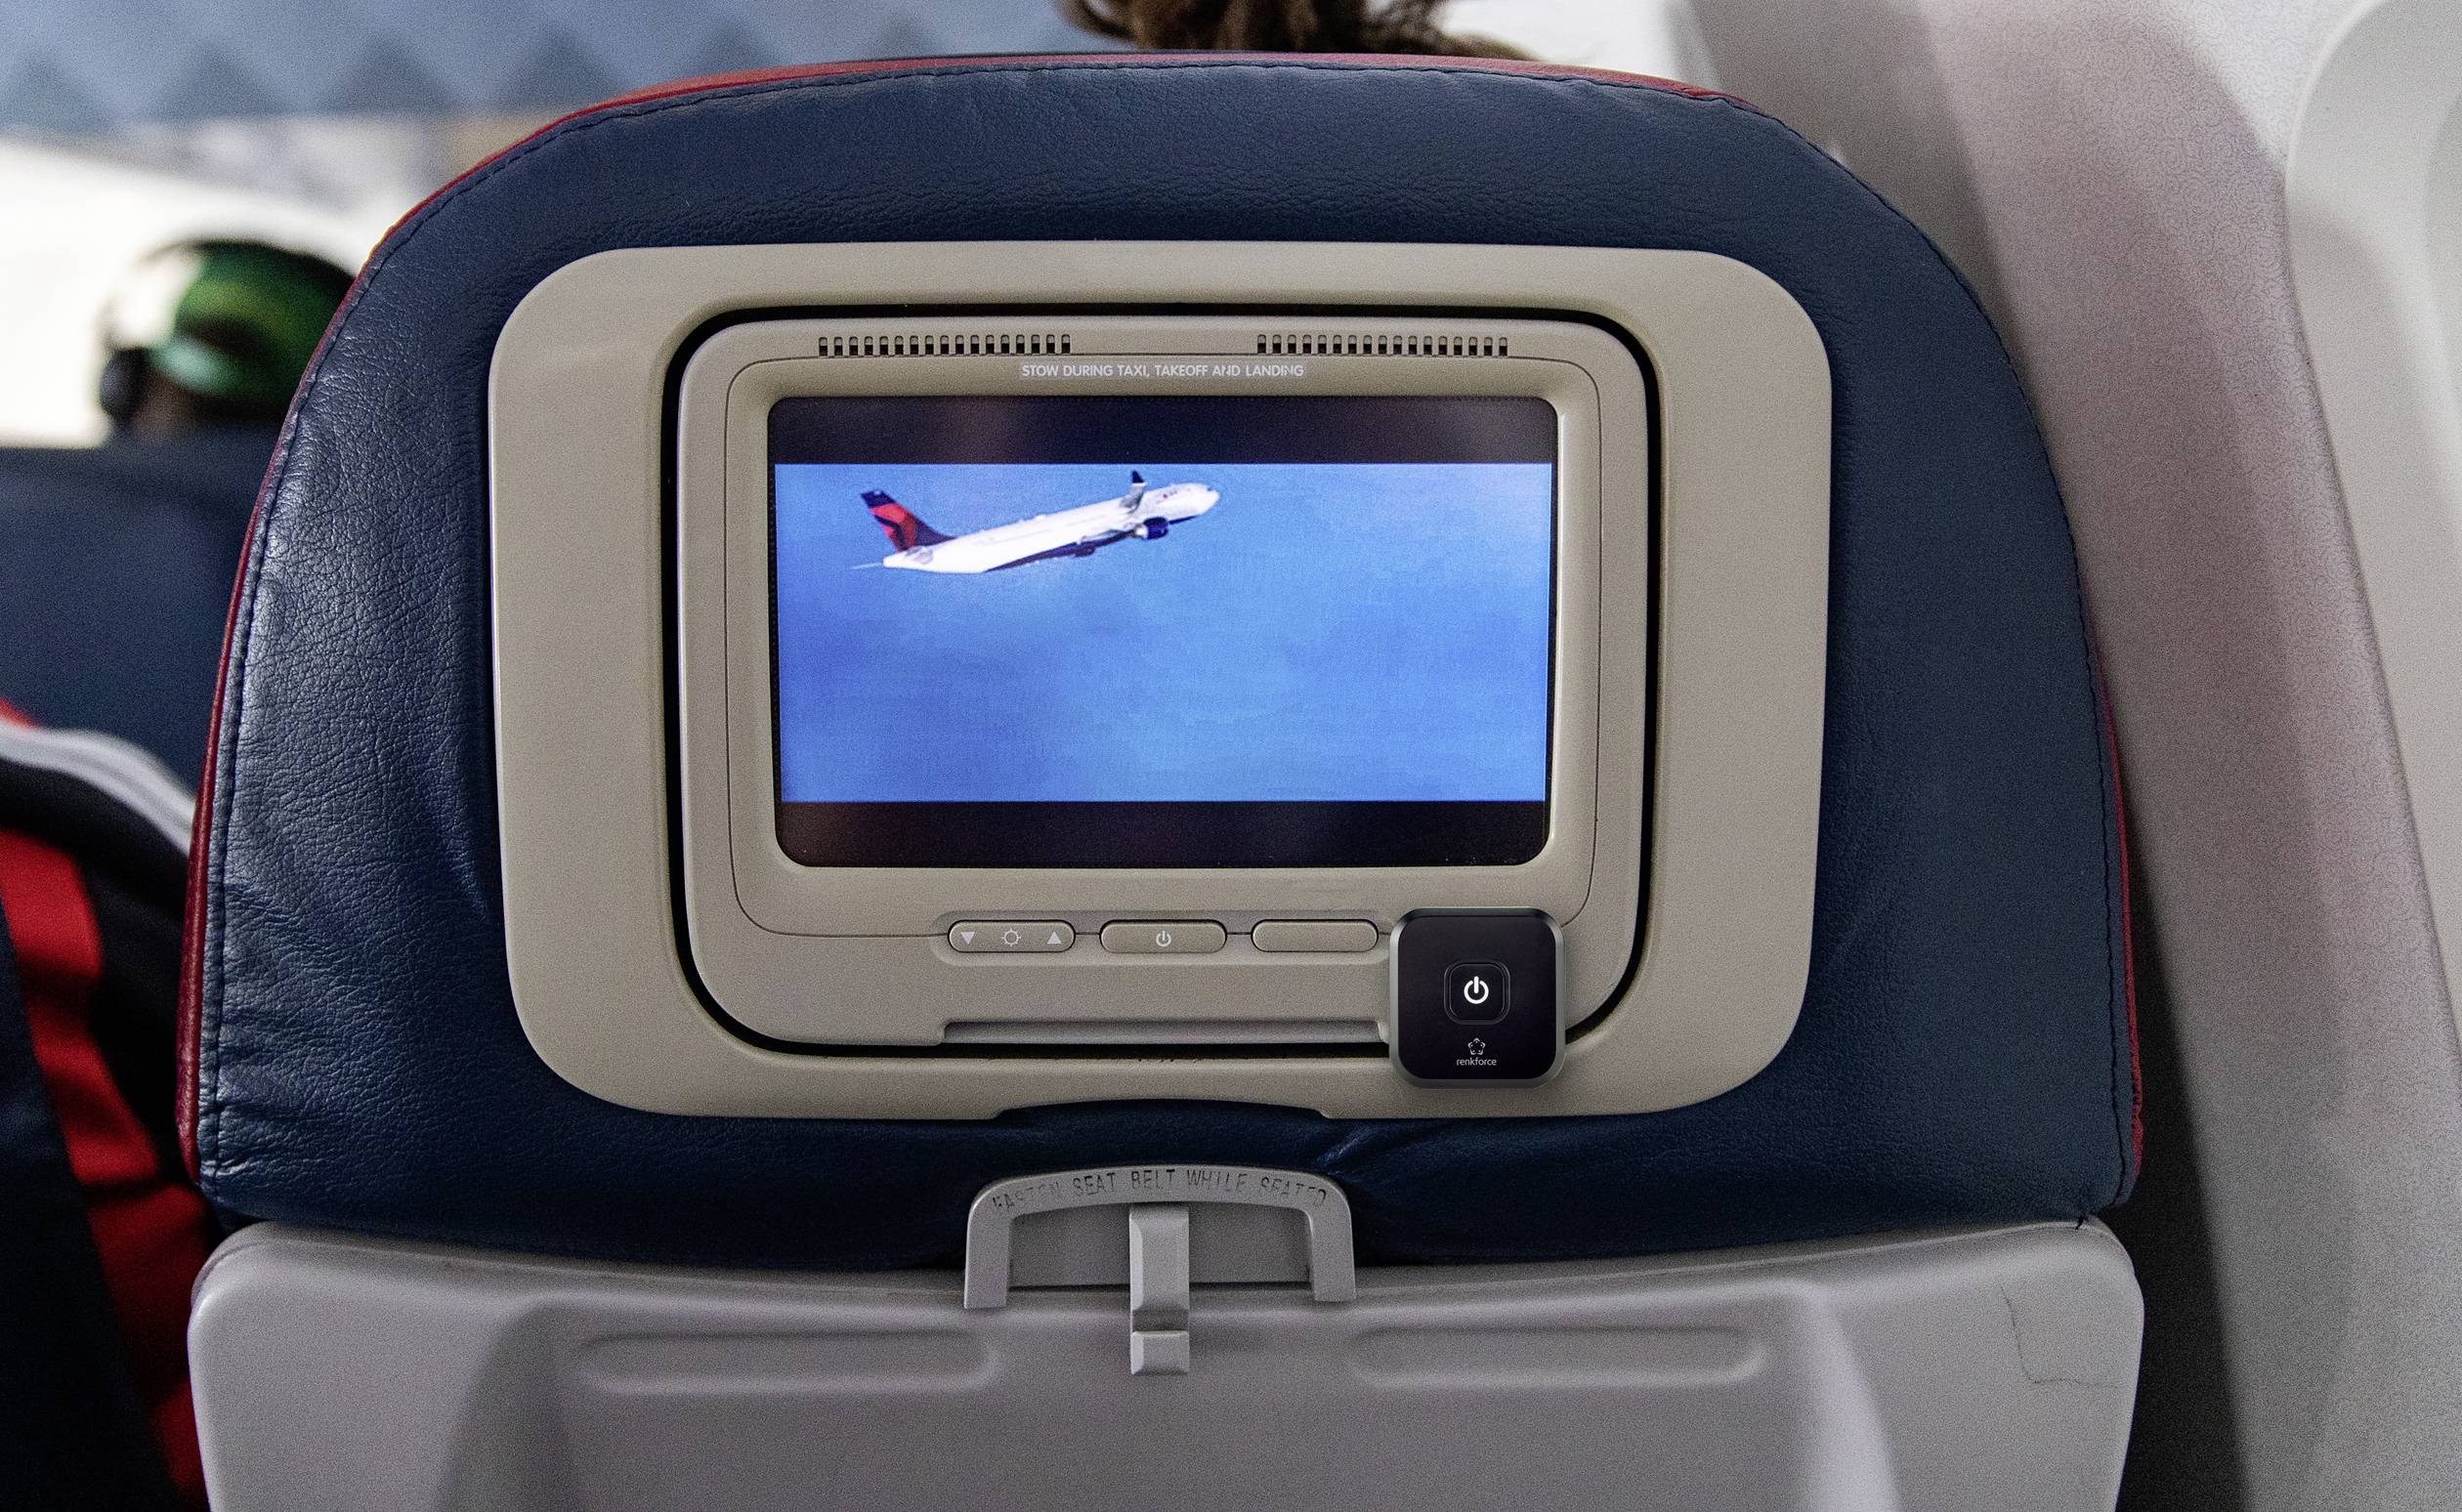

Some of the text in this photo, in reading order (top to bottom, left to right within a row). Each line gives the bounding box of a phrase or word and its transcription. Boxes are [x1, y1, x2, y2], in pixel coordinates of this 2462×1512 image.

[1021, 364, 1304, 378] STOW DURING TAXI, TAKEOFF AND LANDING
[1456, 1057, 1497, 1066] renkforce
[1072, 1172, 1117, 1197] SEAT
[1130, 1170, 1175, 1191] BELT
[1186, 1169, 1248, 1194] WHILE
